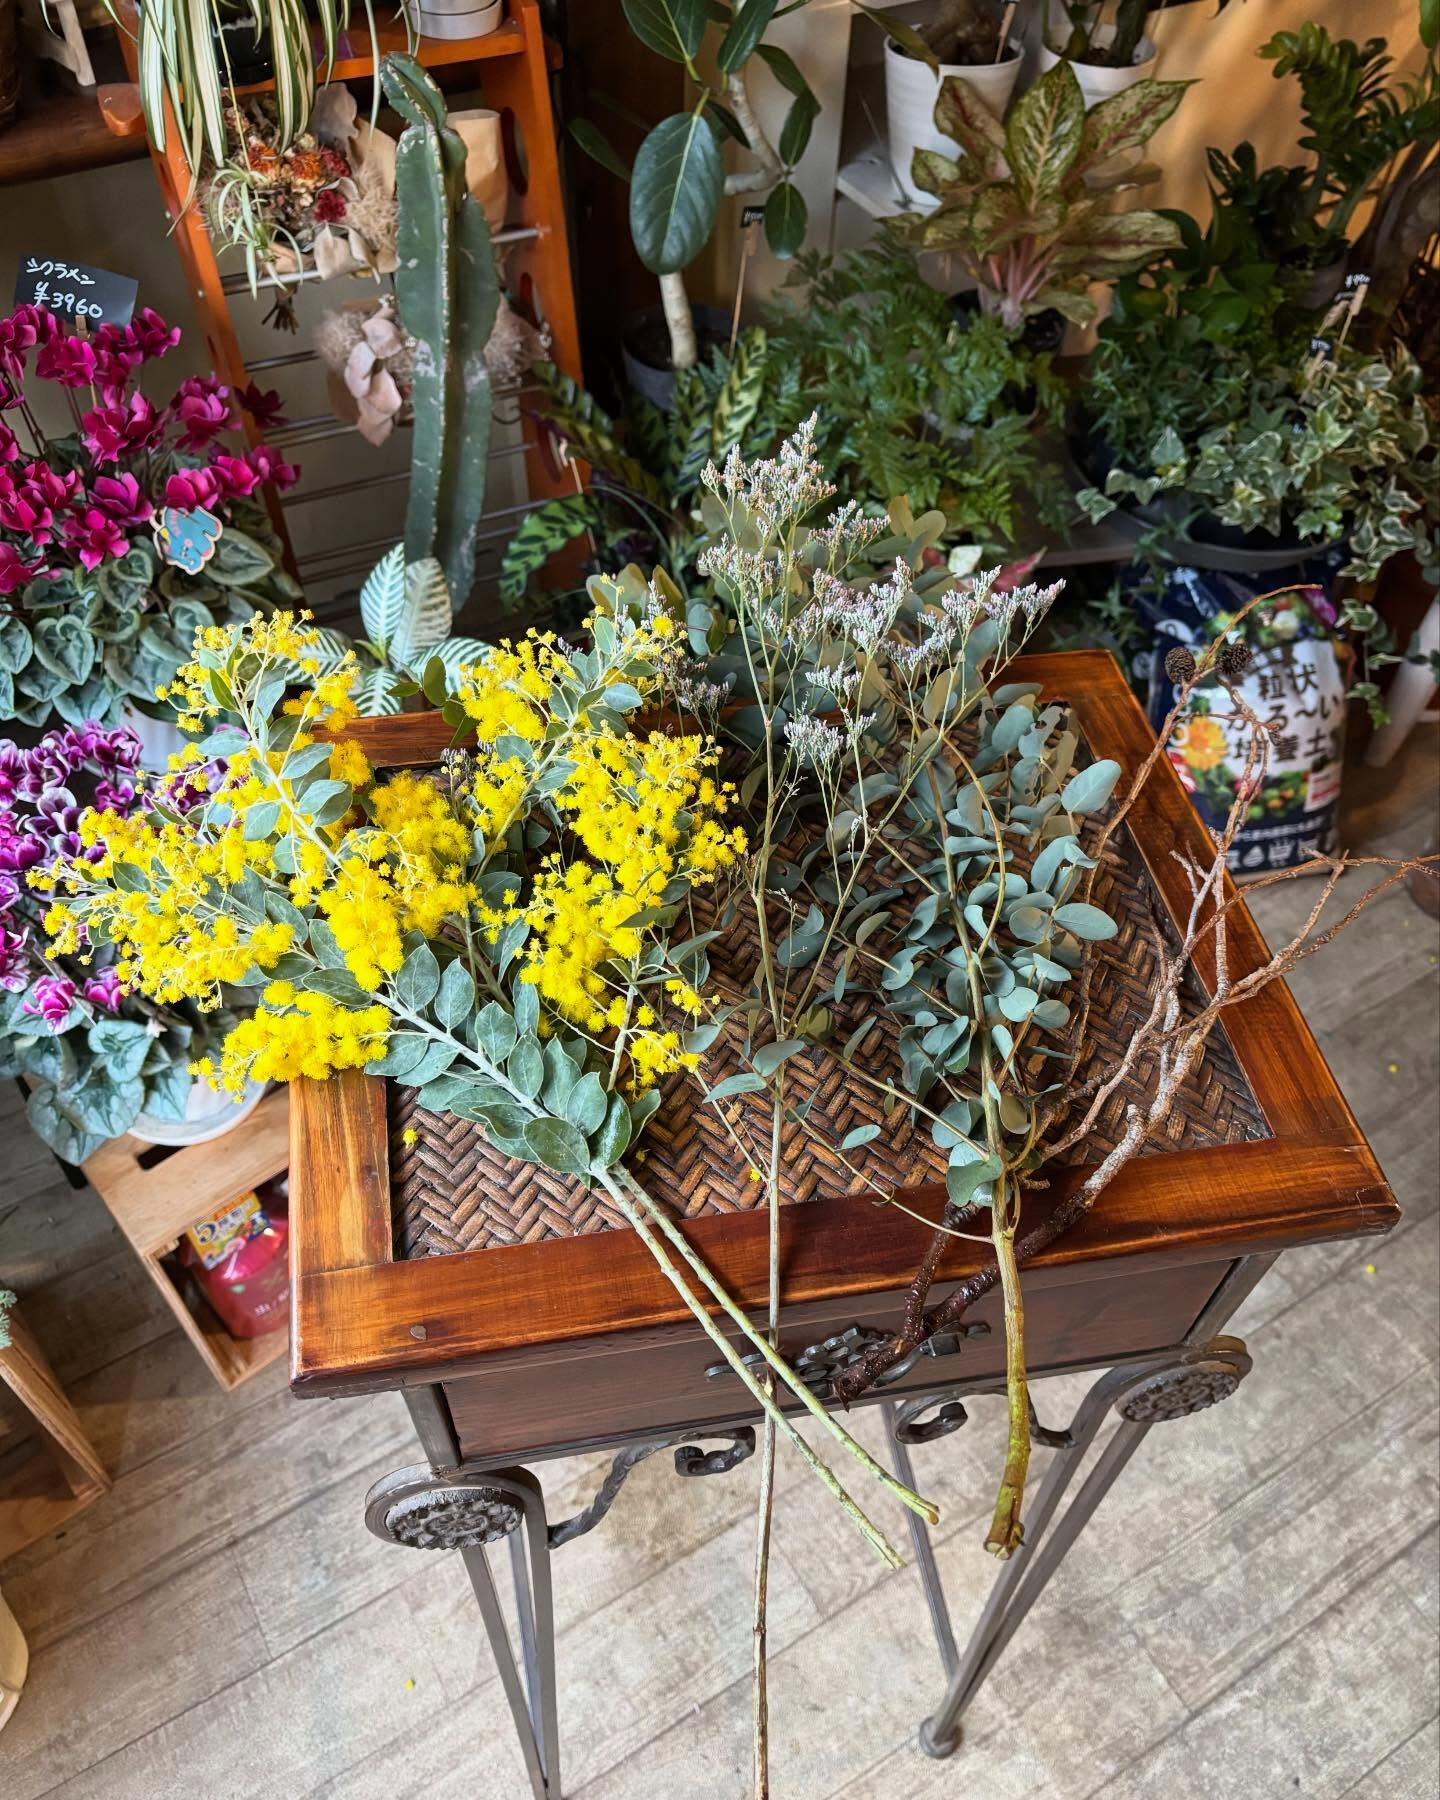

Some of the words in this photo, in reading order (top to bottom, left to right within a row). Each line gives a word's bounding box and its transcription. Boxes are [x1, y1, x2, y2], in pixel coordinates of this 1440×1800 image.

[26, 258, 96, 285] シクラメン
[33, 281, 103, 318] ¥3960
